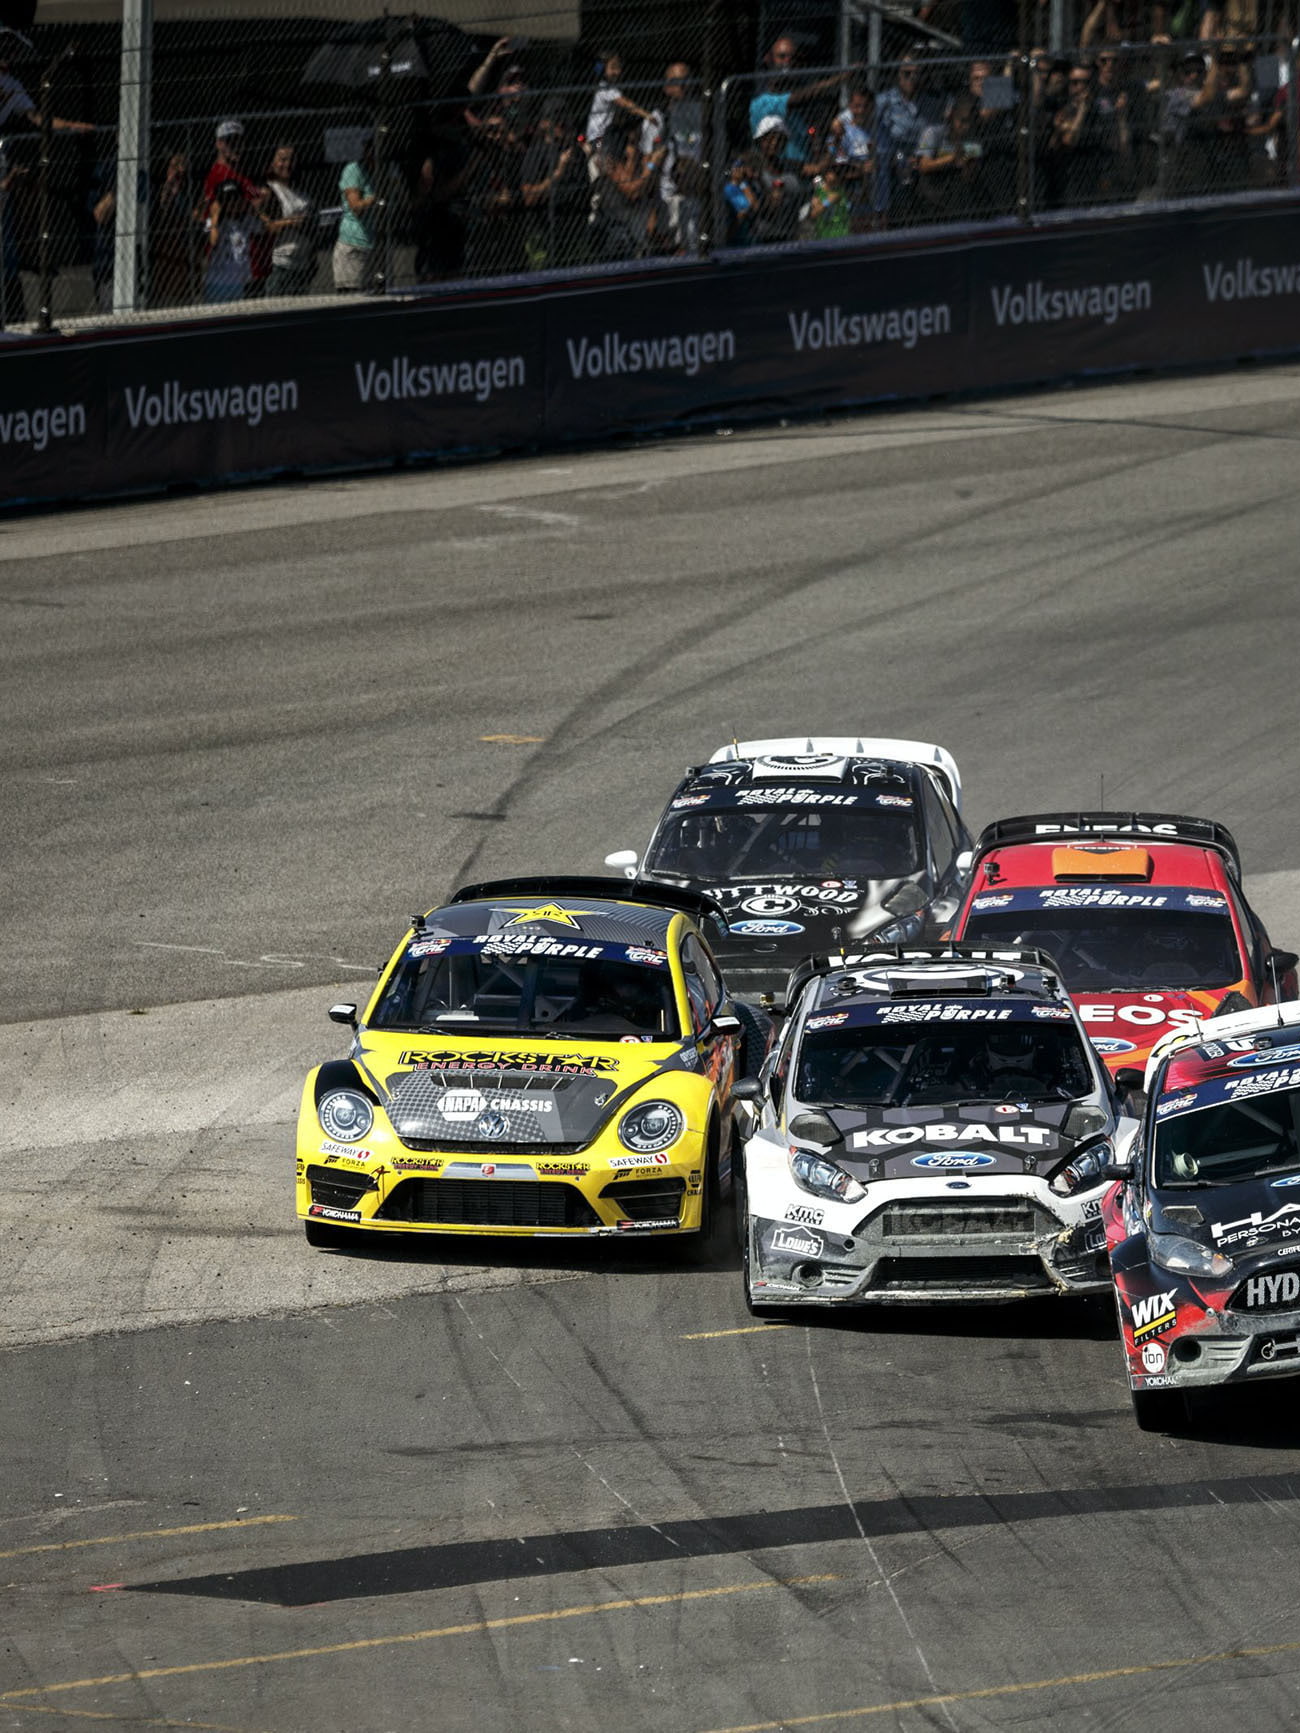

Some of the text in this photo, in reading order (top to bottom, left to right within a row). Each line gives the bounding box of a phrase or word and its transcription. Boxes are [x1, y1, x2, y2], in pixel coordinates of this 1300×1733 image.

[991, 280, 1152, 326] Volkswagen
[788, 303, 951, 352] Volkswagen
[566, 329, 735, 379] Volkswagen
[354, 355, 525, 403] Volkswagen
[124, 379, 298, 428] Volkswagen
[778, 794, 858, 806] PURPLE
[701, 884, 859, 903] UTTWOOD
[1039, 888, 1102, 898] ROYAL
[1083, 894, 1168, 907] PURPLE
[472, 934, 538, 945] ROYAL
[514, 941, 604, 959] PURPLE
[876, 1003, 942, 1014] ROYAL
[924, 1009, 1013, 1021] PURPLE
[1079, 1003, 1204, 1028] EOS
[416, 1061, 595, 1075] ENERGY DRINK
[1223, 1067, 1293, 1090] ROYAL
[441, 1096, 553, 1113] NAPA CHASSIS
[322, 1142, 358, 1157] SAFEWAY
[610, 1156, 654, 1168] SAFEWAY
[636, 1167, 663, 1175] FORZA
[1131, 1287, 1179, 1329] WIX
[1134, 1318, 1178, 1347] FILTERS
[1143, 1346, 1163, 1364] ion
